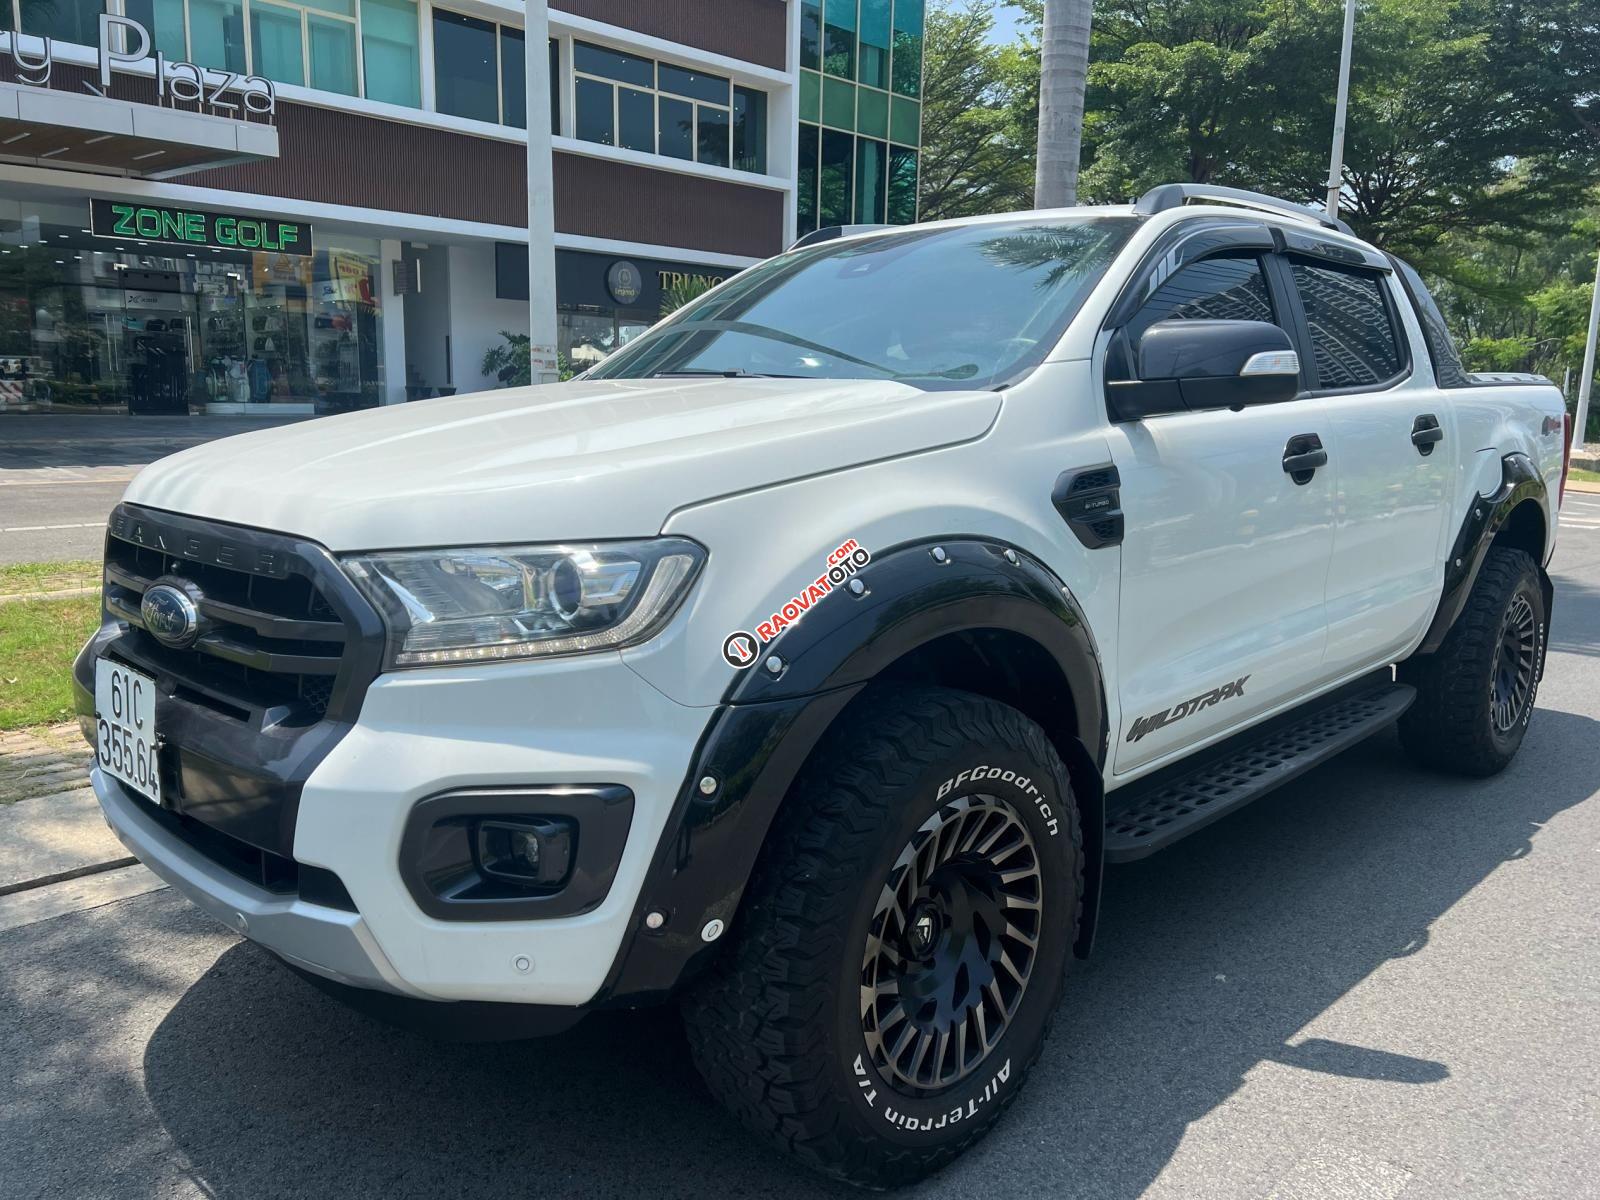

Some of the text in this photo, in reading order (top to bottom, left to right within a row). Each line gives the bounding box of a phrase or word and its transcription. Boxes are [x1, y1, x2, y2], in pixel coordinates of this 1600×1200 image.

[98, 13, 276, 116] Plaza
[112, 205, 298, 251] ZONE GOLF
[146, 595, 176, 631] Ford
[111, 669, 143, 730] 61C
[1126, 674, 1252, 743] WILDTRAK
[99, 718, 159, 796] 355.64
[936, 764, 1059, 837] BFGoodrich
[883, 1058, 1012, 1132] All-Terrain
